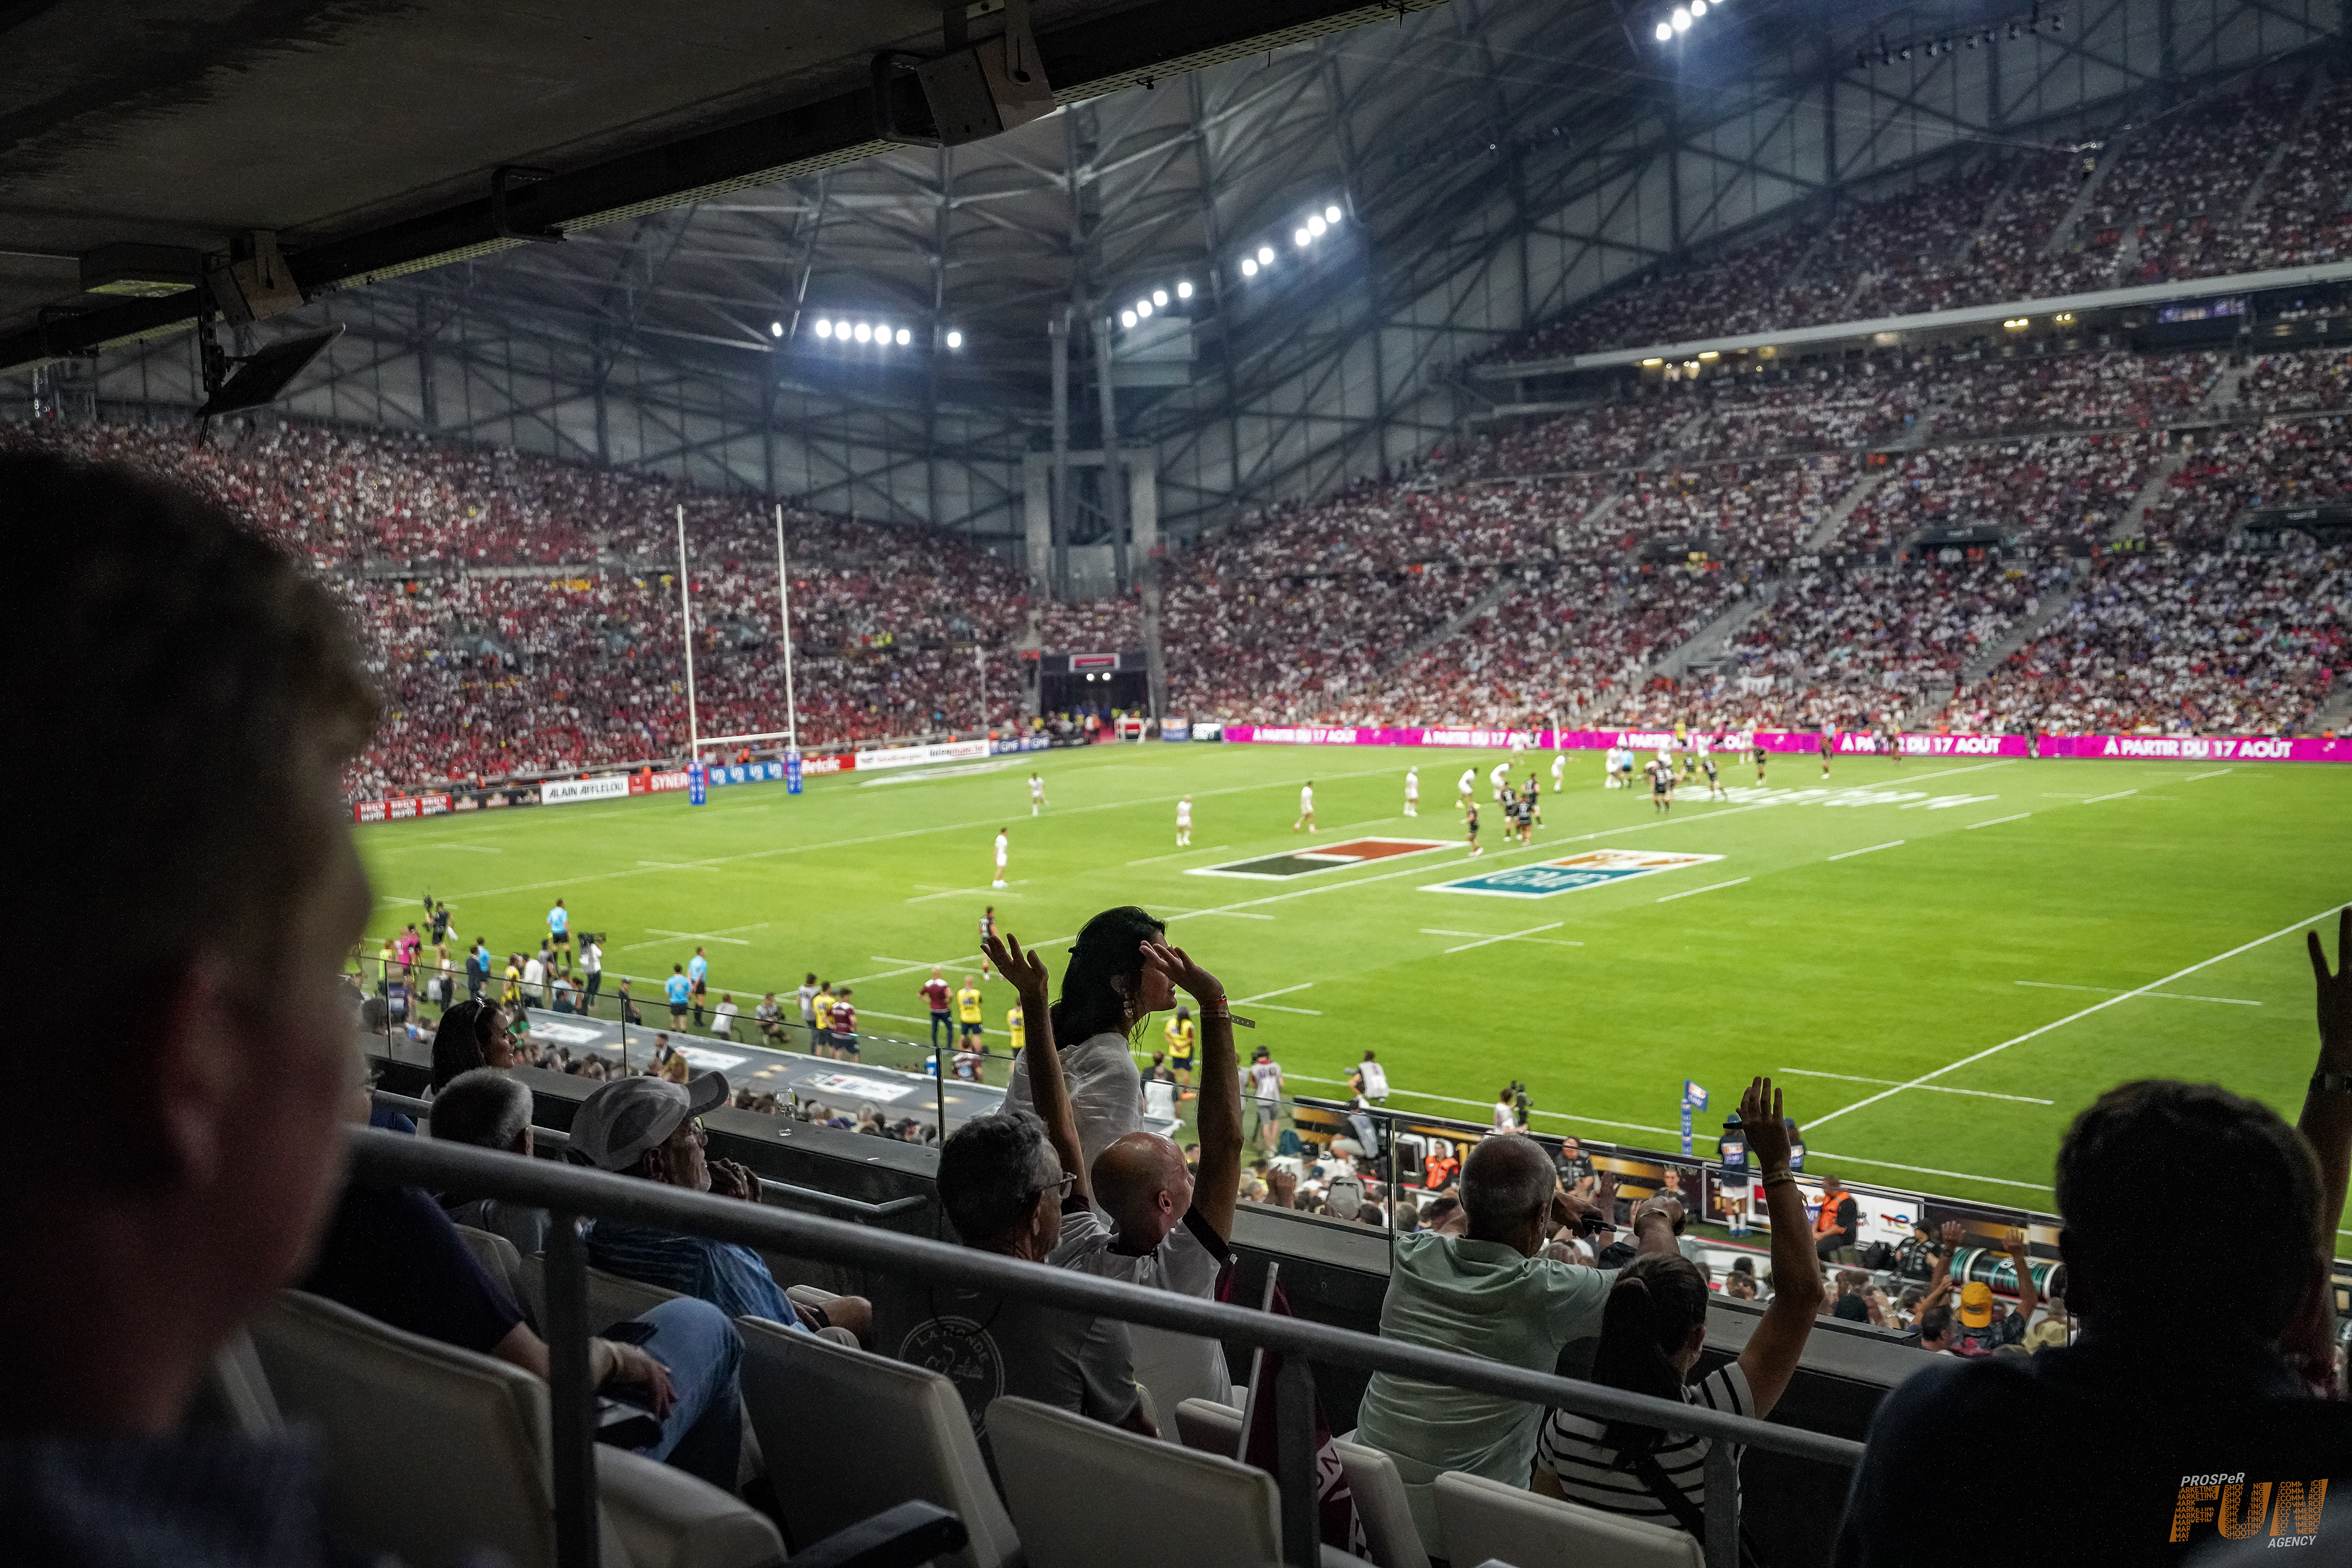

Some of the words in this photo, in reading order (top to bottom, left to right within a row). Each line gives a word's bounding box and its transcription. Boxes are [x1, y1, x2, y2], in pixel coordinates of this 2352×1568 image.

[1840, 733, 1855, 752] À
[1906, 736, 1930, 753] DU
[1933, 737, 1954, 753] 17
[1954, 734, 2002, 754] AOÛT
[2103, 735, 2119, 756] À
[2120, 739, 2180, 756] PARTIR
[2180, 740, 2209, 757] DU
[2213, 741, 2238, 757] 17
[2238, 737, 2293, 758] AOÛT
[801, 756, 841, 774] Betclic
[650, 772, 688, 790] SYNER
[549, 785, 578, 799] ALAIN
[580, 782, 624, 796] AFFLELOU
